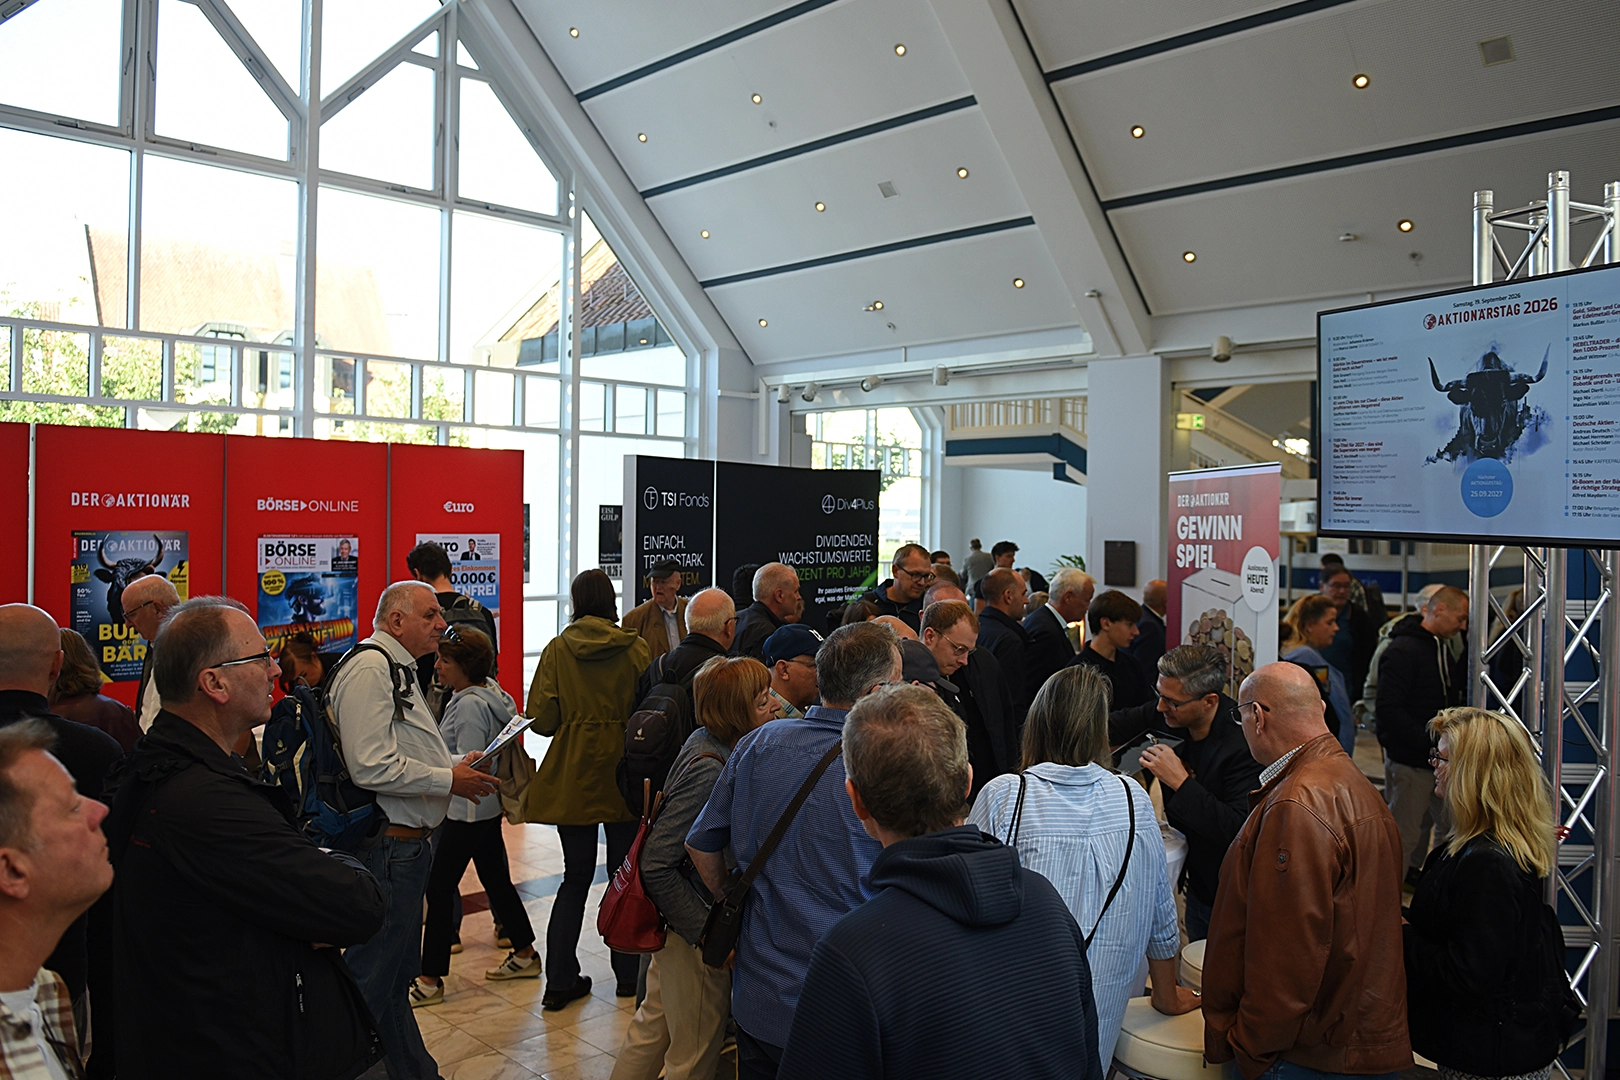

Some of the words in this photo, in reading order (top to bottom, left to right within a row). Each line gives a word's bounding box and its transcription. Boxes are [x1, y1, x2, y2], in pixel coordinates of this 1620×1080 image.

[1481, 296, 1508, 304] September
[1438, 303, 1520, 326] AKTIONÄRSTAG
[1523, 297, 1558, 314] 2026
[1573, 339, 1610, 347] HEBELTRADER
[1582, 373, 1613, 381] Megatrends
[71, 492, 99, 506] DER
[116, 493, 190, 507] AKTIONÄR
[257, 497, 299, 511] BÖRSE
[308, 500, 359, 512] ONLINE
[661, 492, 677, 506] TSI
[679, 492, 710, 508] Fonds
[837, 498, 874, 510] Div4Plus
[1178, 494, 1189, 507] DER
[1195, 492, 1229, 506] AKTIONÄR
[443, 501, 474, 513] €uro
[1177, 515, 1242, 540] GEWINN
[119, 539, 181, 552] AKTIOÄR
[643, 535, 685, 550] EINFACH.
[816, 534, 873, 548] DIVIDENDEN.
[265, 541, 316, 557] BÖRSE
[1176, 543, 1216, 569] SPIEL
[274, 556, 316, 566] ONLINE
[778, 549, 873, 565] WACHSTUMSWERTE.
[826, 566, 845, 579] PRO
[1248, 565, 1268, 573] Auslosung
[1247, 574, 1268, 585] HEUTE
[825, 587, 843, 595] passives
[263, 623, 305, 638] AKTIEN
